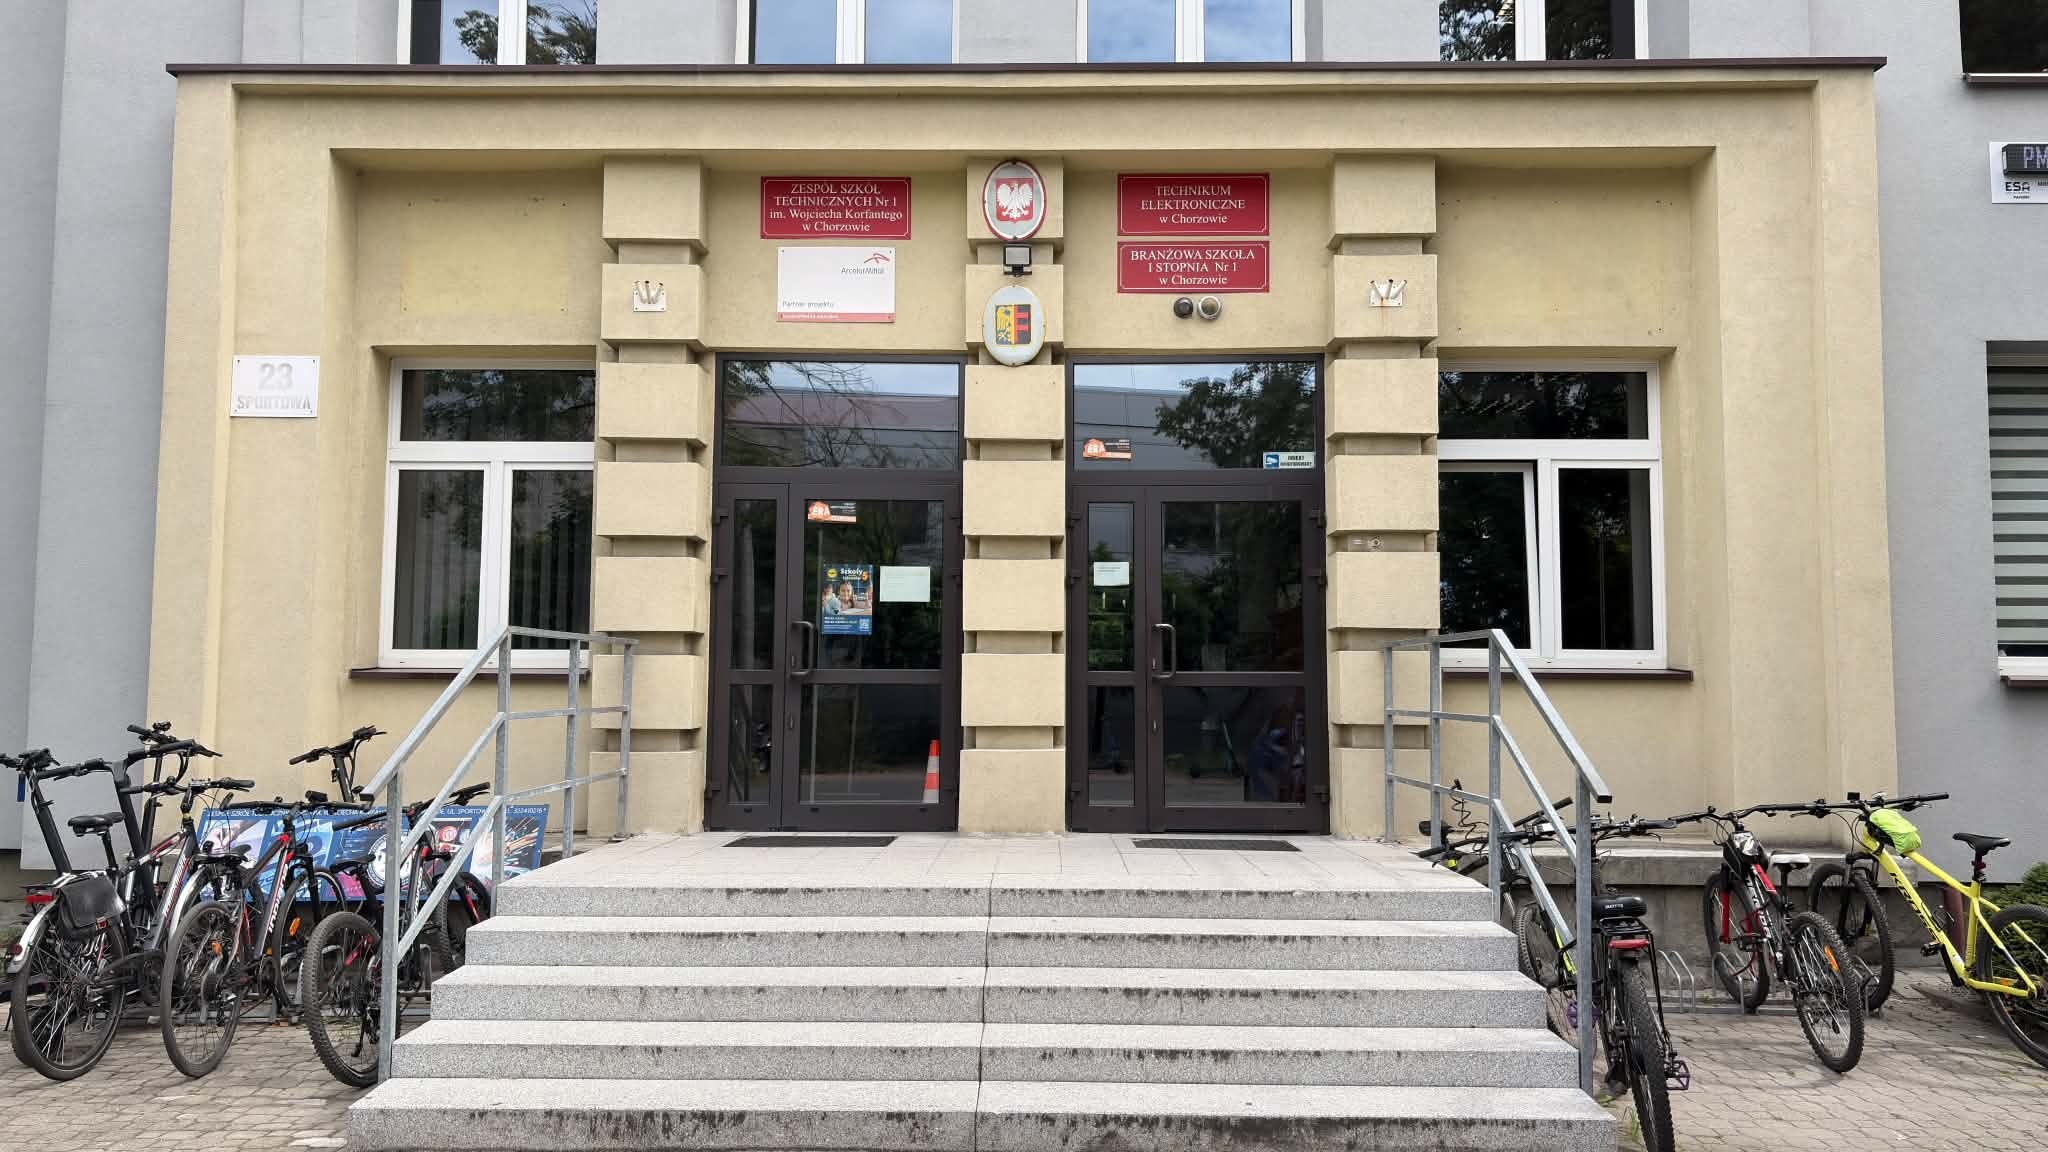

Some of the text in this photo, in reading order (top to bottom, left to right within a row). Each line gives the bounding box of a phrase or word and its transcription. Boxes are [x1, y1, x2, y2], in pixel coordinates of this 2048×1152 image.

[791, 182, 881, 194] ZESPÓŁ SZKÓŁ
[1155, 185, 1232, 196] TECHNIKUM
[775, 196, 873, 207] TECHNICZNYCH
[875, 197, 889, 207] Nr
[1141, 199, 1246, 210] ELEKTRONICZNE
[769, 209, 903, 221] im. Wojciecha Korfantego
[1159, 213, 1228, 224] w Chorzowie
[814, 221, 871, 232] Chorzowie
[1131, 248, 1255, 261] BRANŻOWA SZKOŁA
[1155, 262, 1209, 272] STOPNIA
[1215, 262, 1229, 272] Nr
[1159, 275, 1228, 285] w Chorzowie
[258, 362, 293, 390] 23
